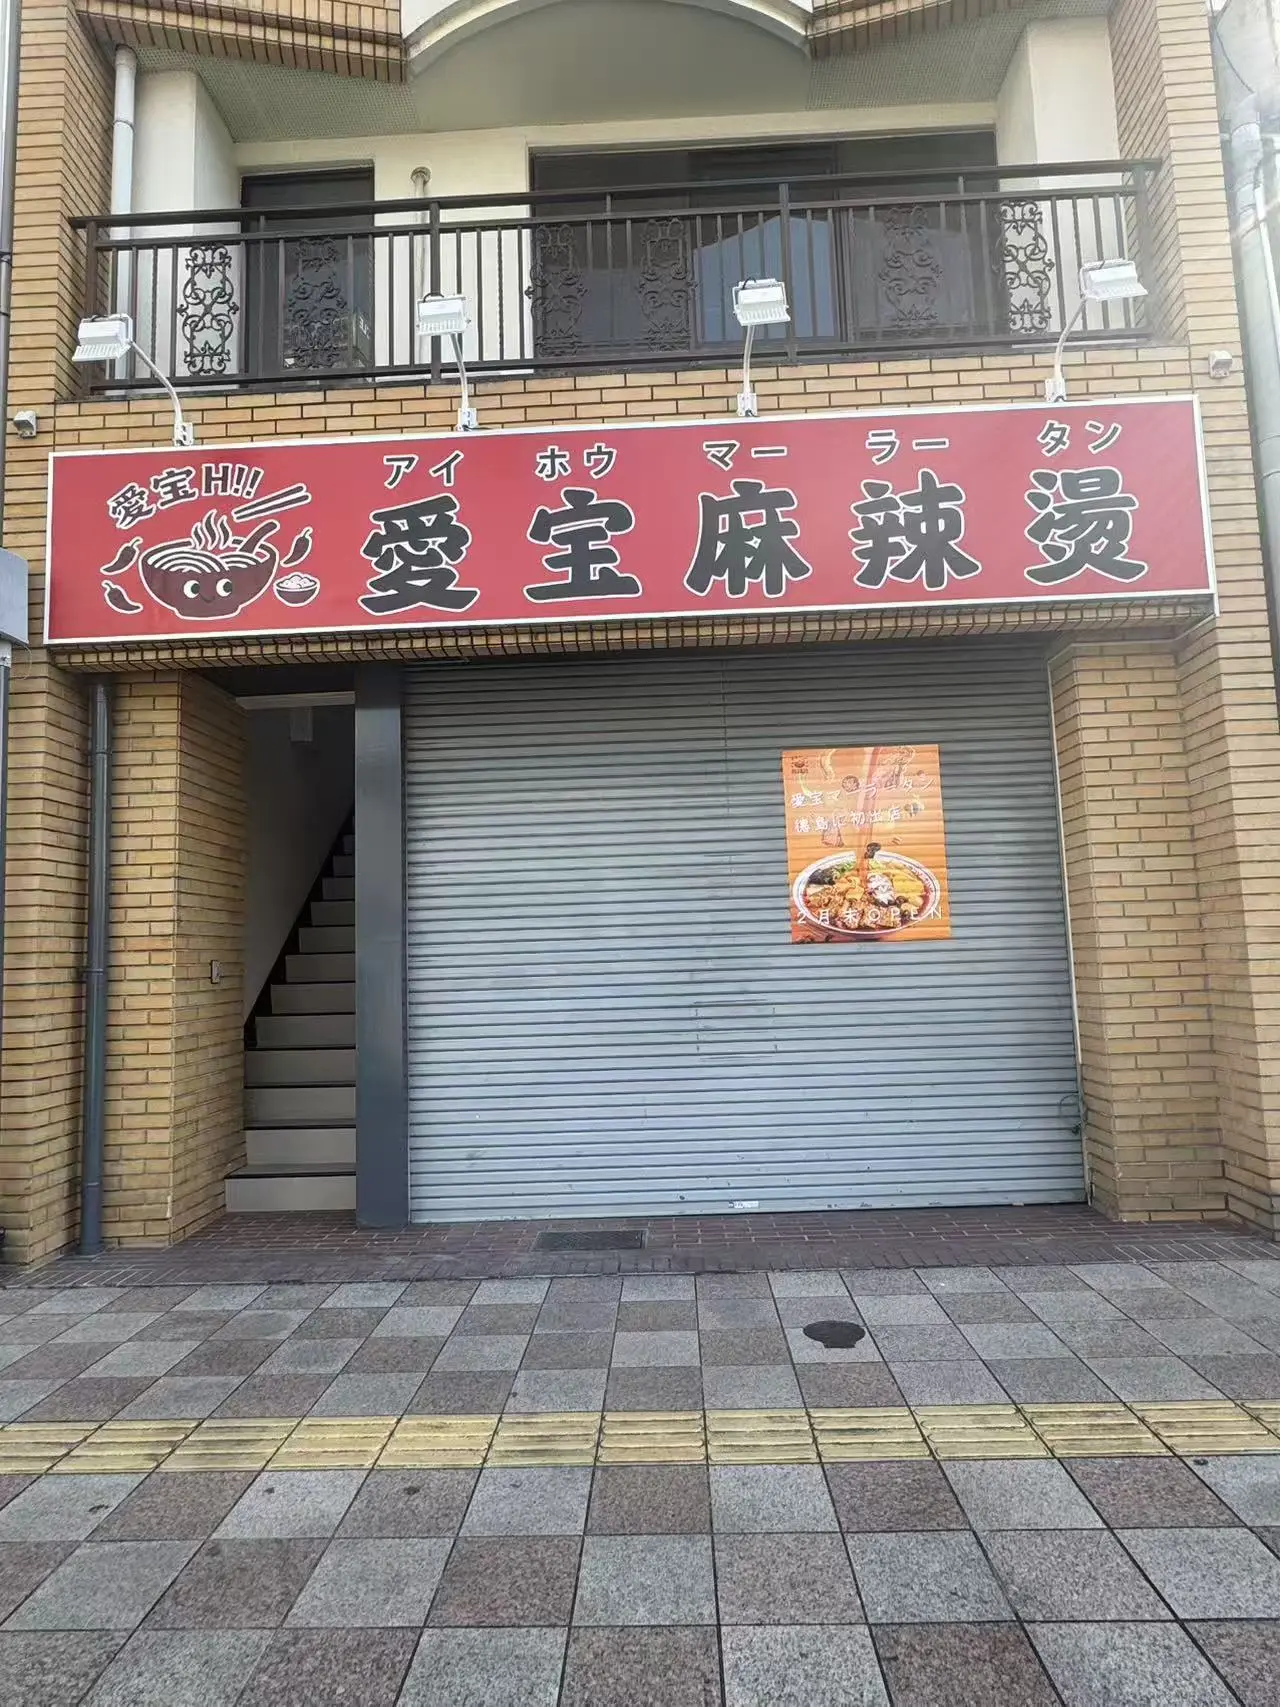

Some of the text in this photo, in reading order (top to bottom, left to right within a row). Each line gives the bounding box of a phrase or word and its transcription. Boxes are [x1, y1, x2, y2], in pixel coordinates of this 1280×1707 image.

[383, 420, 1122, 488] アイ ホウ マー ラー タン
